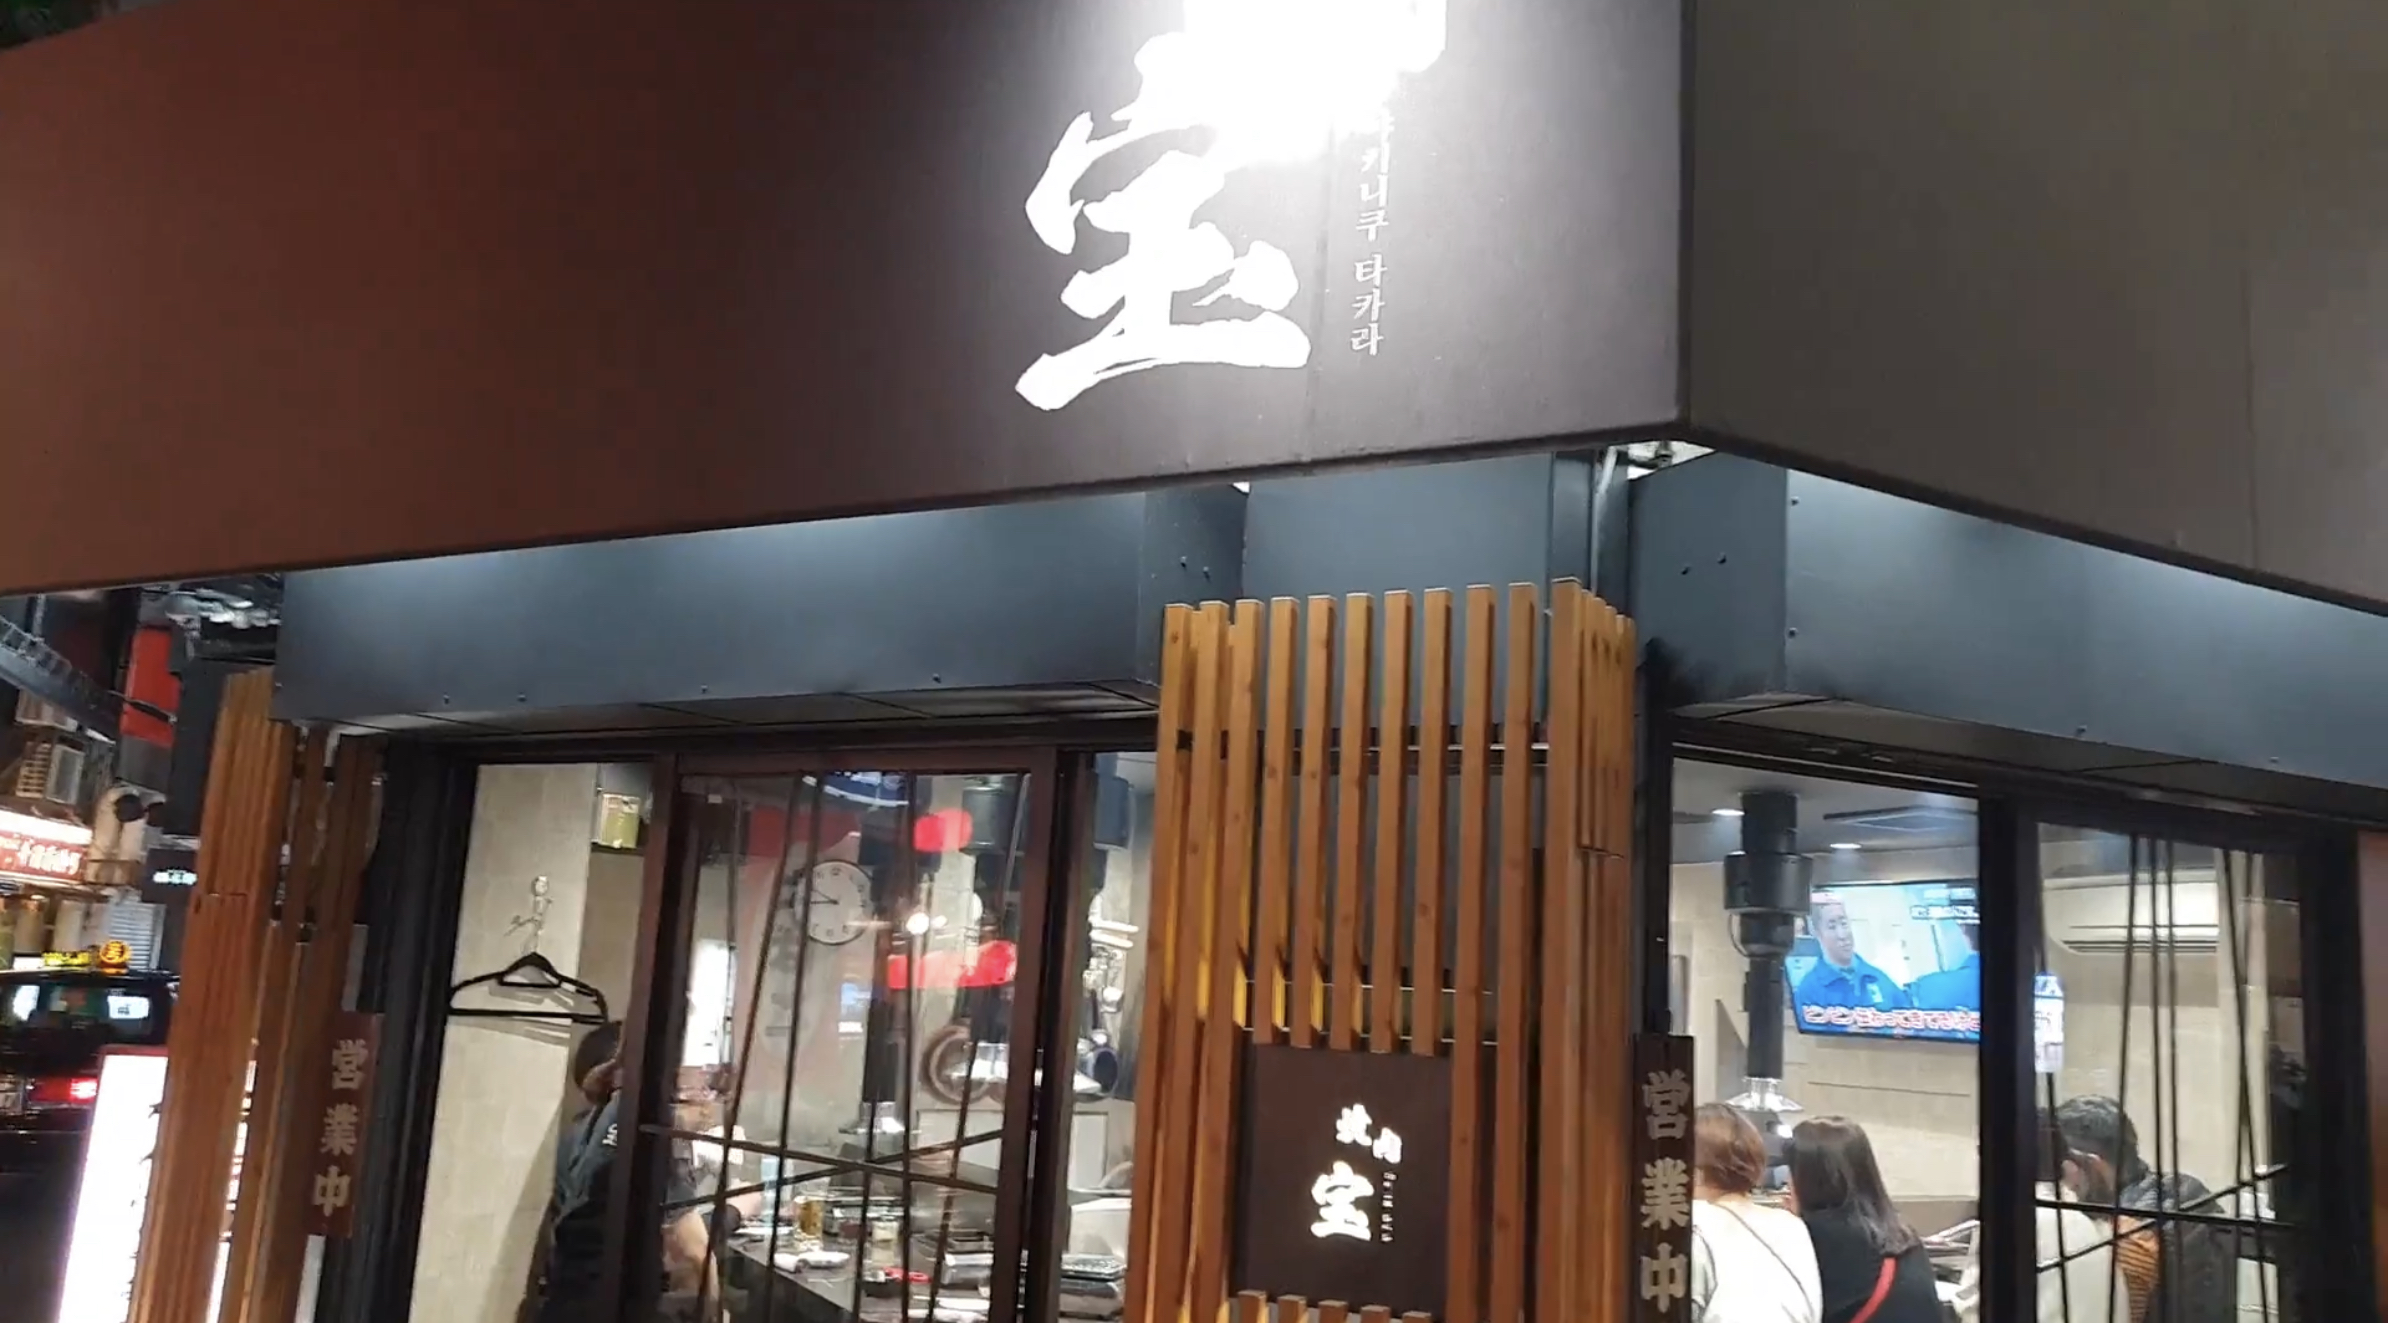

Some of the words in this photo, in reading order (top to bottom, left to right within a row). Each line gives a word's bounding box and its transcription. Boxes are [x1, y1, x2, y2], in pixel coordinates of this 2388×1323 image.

[1351, 253, 1388, 356] 타카라
[312, 1038, 368, 1217] 営業中
[1640, 1068, 1690, 1314] 営業中
[1310, 1161, 1375, 1241] 宝
